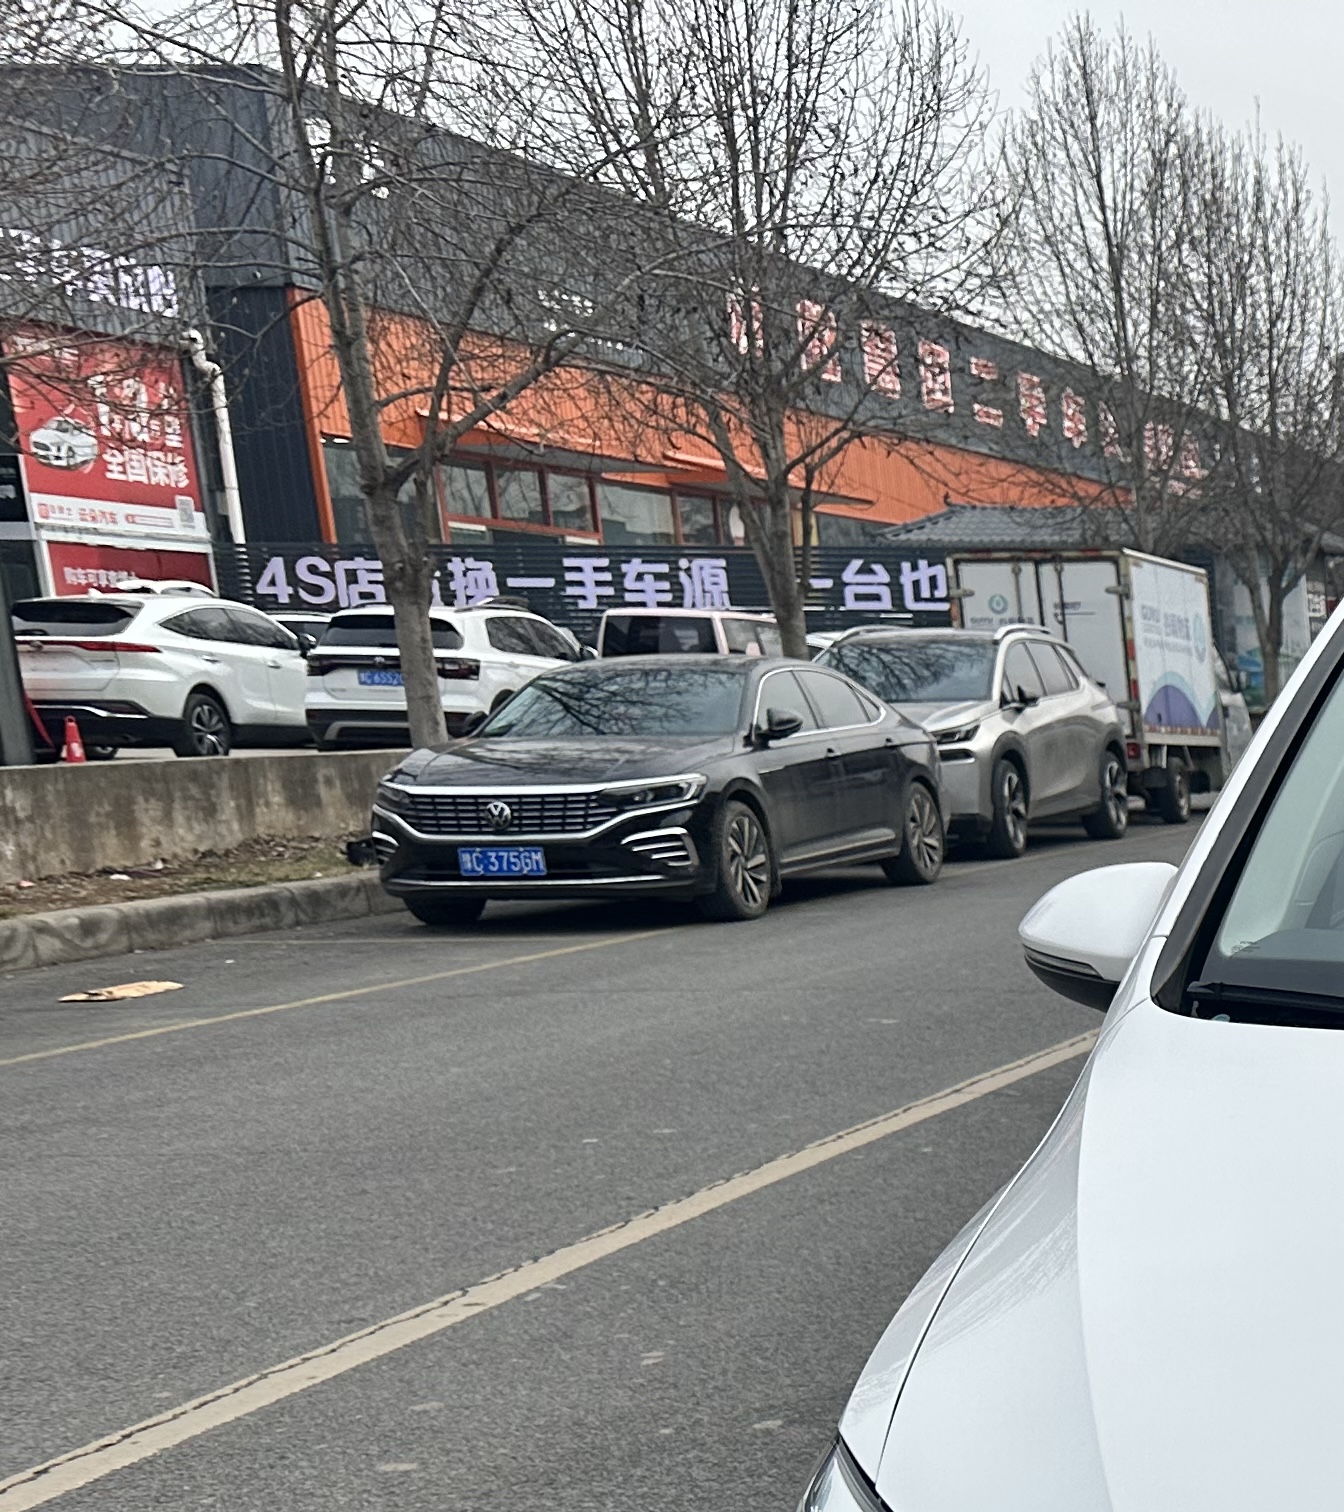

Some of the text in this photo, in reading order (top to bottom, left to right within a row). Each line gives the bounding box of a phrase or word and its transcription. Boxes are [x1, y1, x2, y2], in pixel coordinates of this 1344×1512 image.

[102, 444, 190, 488] 全国保修
[256, 555, 731, 609] 4S店换一手车源
